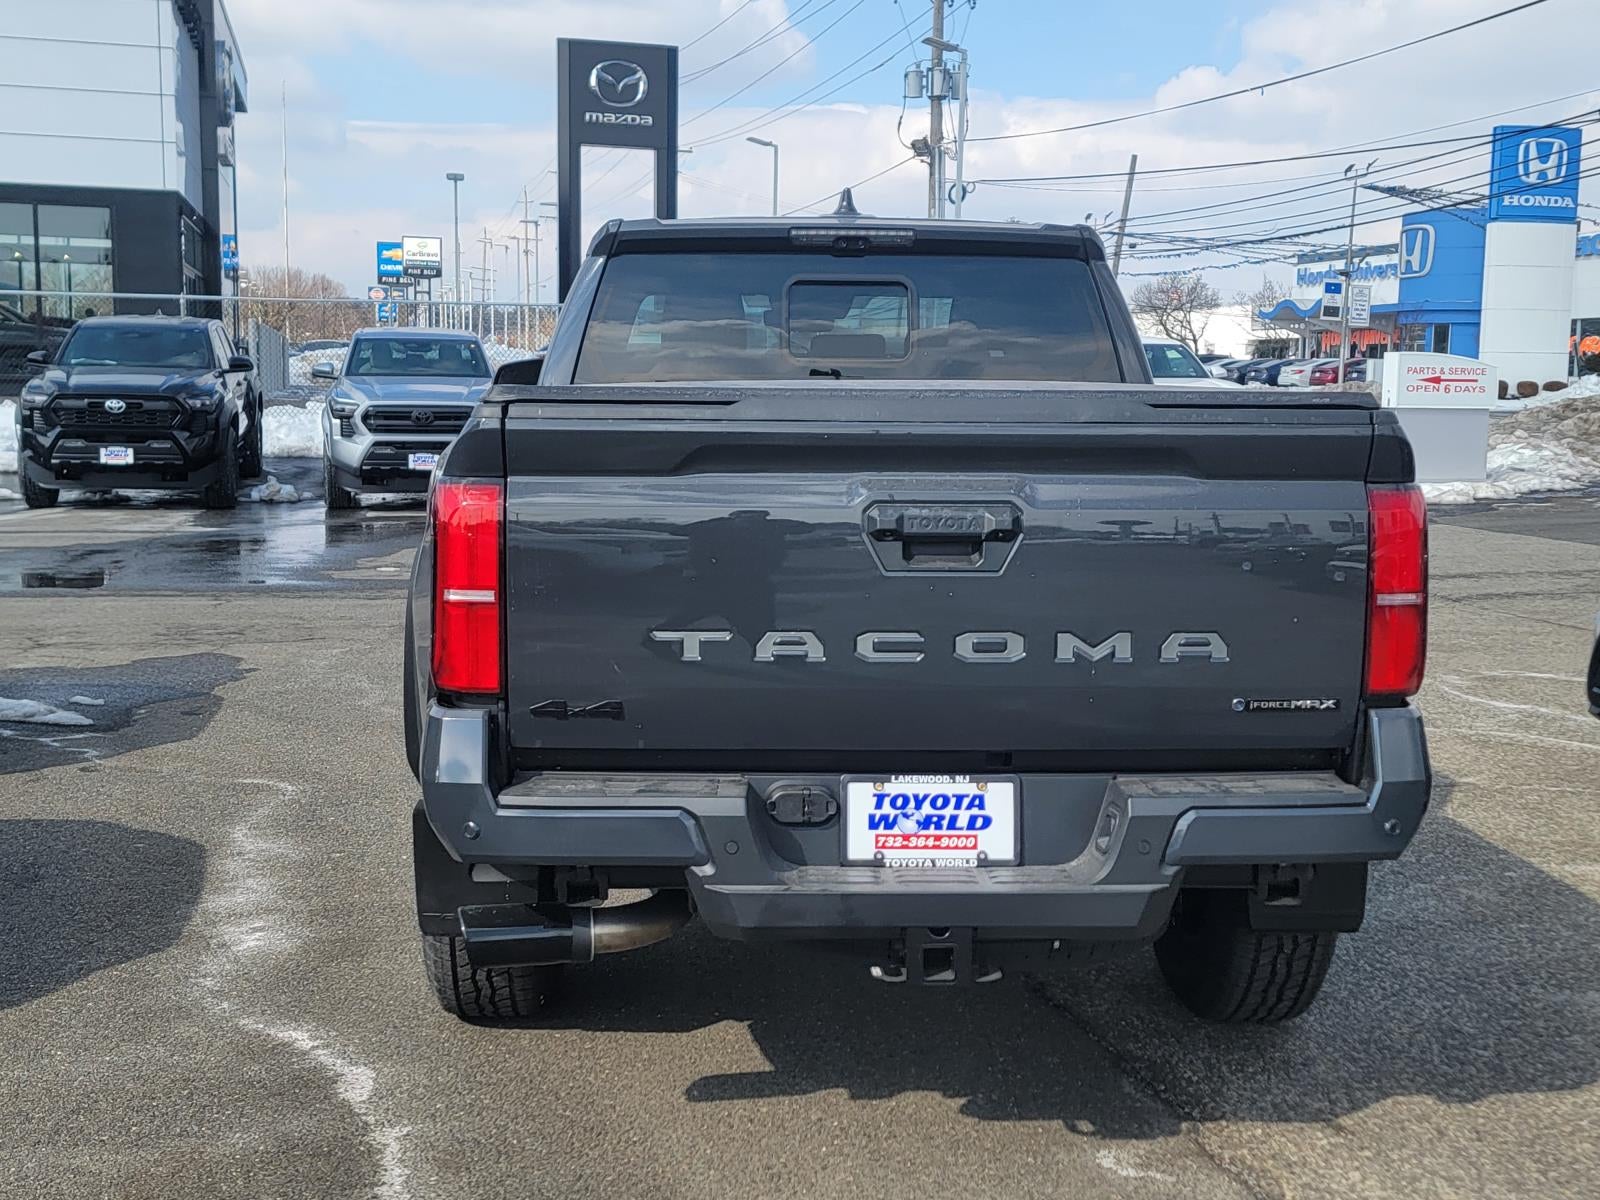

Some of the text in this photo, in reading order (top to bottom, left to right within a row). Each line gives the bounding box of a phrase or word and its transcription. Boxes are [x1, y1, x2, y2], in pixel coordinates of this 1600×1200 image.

[1502, 195, 1576, 208] HONDA
[406, 250, 439, 258] CarBravo
[1407, 367, 1488, 376] PARTS & SERVICE
[1406, 384, 1486, 394] OPEN 6 DAYS
[908, 517, 980, 530] TOYOTA
[650, 631, 1230, 662] TACOMA
[955, 775, 970, 784] NJ
[872, 793, 986, 811] TOYOTA
[876, 836, 976, 848] 732-364-9000
[884, 858, 978, 867] TOYOTA WORLD
